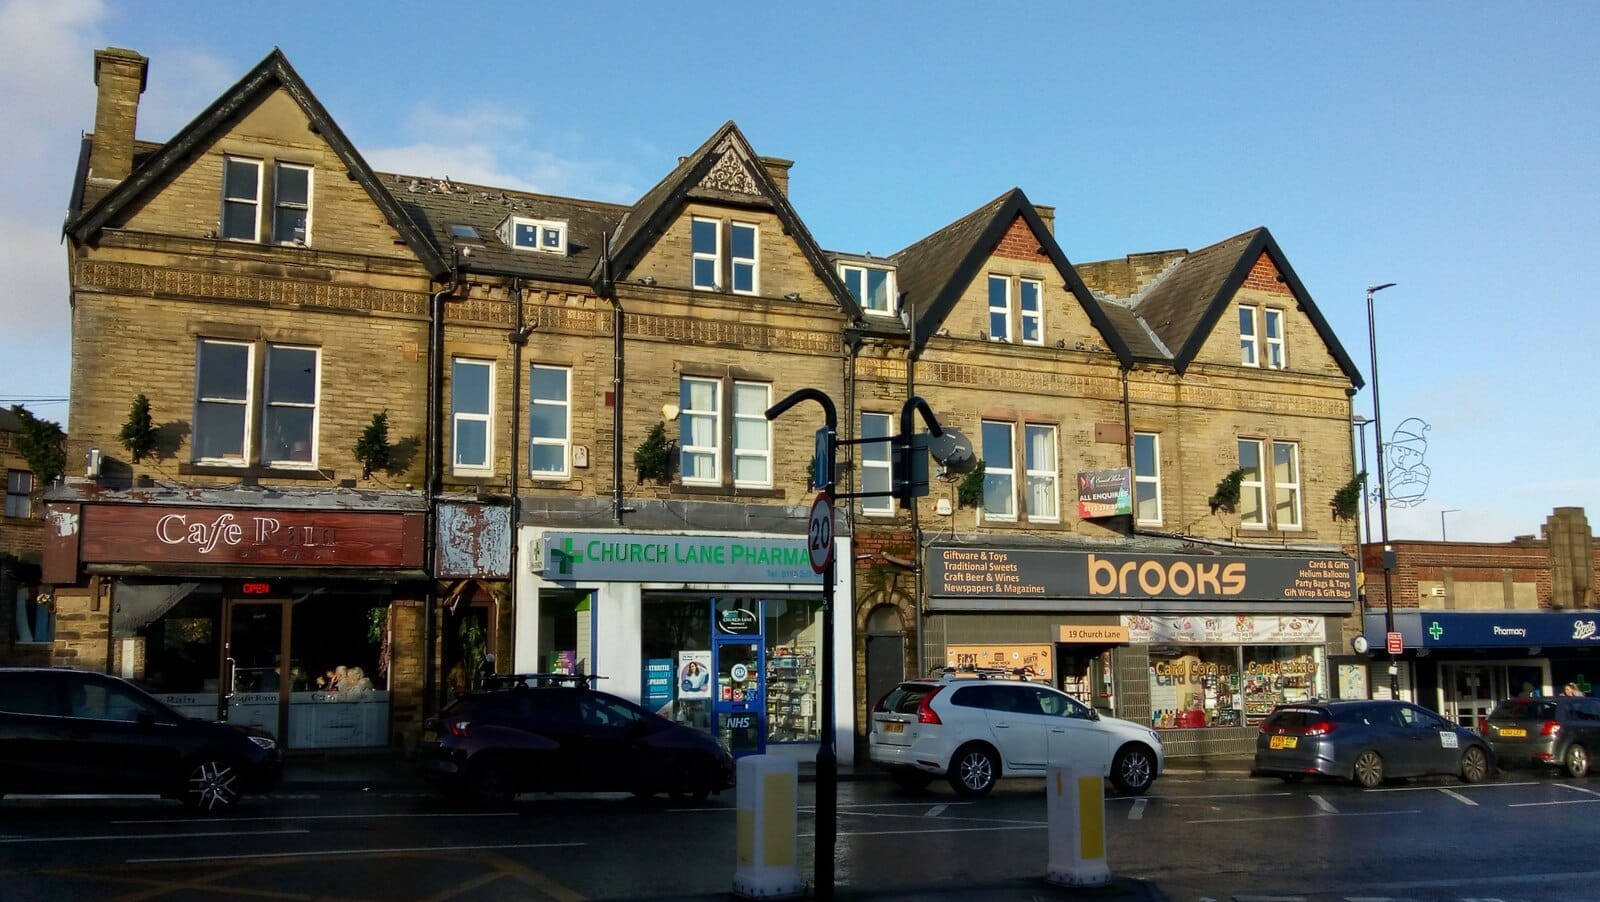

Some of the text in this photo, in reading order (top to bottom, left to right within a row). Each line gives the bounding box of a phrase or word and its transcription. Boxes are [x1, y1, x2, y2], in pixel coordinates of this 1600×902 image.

[156, 513, 242, 554] Cafe
[811, 516, 830, 550] 20
[587, 540, 669, 564] CHURCH
[675, 542, 725, 566] LANE
[943, 551, 1008, 563] Giftware & Toys
[944, 562, 1018, 572] Traditional Sweets
[1309, 560, 1350, 569] Cards & Gifts
[944, 572, 1020, 583] Craft Beer & Wines
[1087, 554, 1246, 595] brooks
[1299, 570, 1350, 579] Helium Balloons
[243, 583, 270, 594] OPEN
[944, 584, 1045, 595] Newspapers & Magazines
[1295, 579, 1350, 590] Party Bags & Toys
[1285, 589, 1297, 597] Gift
[1298, 589, 1316, 599] Wrap
[1337, 590, 1352, 599] Bags
[1069, 630, 1078, 639] 19
[1079, 630, 1103, 639] Church
[1104, 630, 1121, 639] Lane
[1493, 625, 1526, 637] Pharmacy
[1572, 620, 1597, 640] Boots
[1155, 661, 1233, 676] Card Corner
[1247, 661, 1320, 675] Card Corner
[726, 717, 751, 728] NHS
